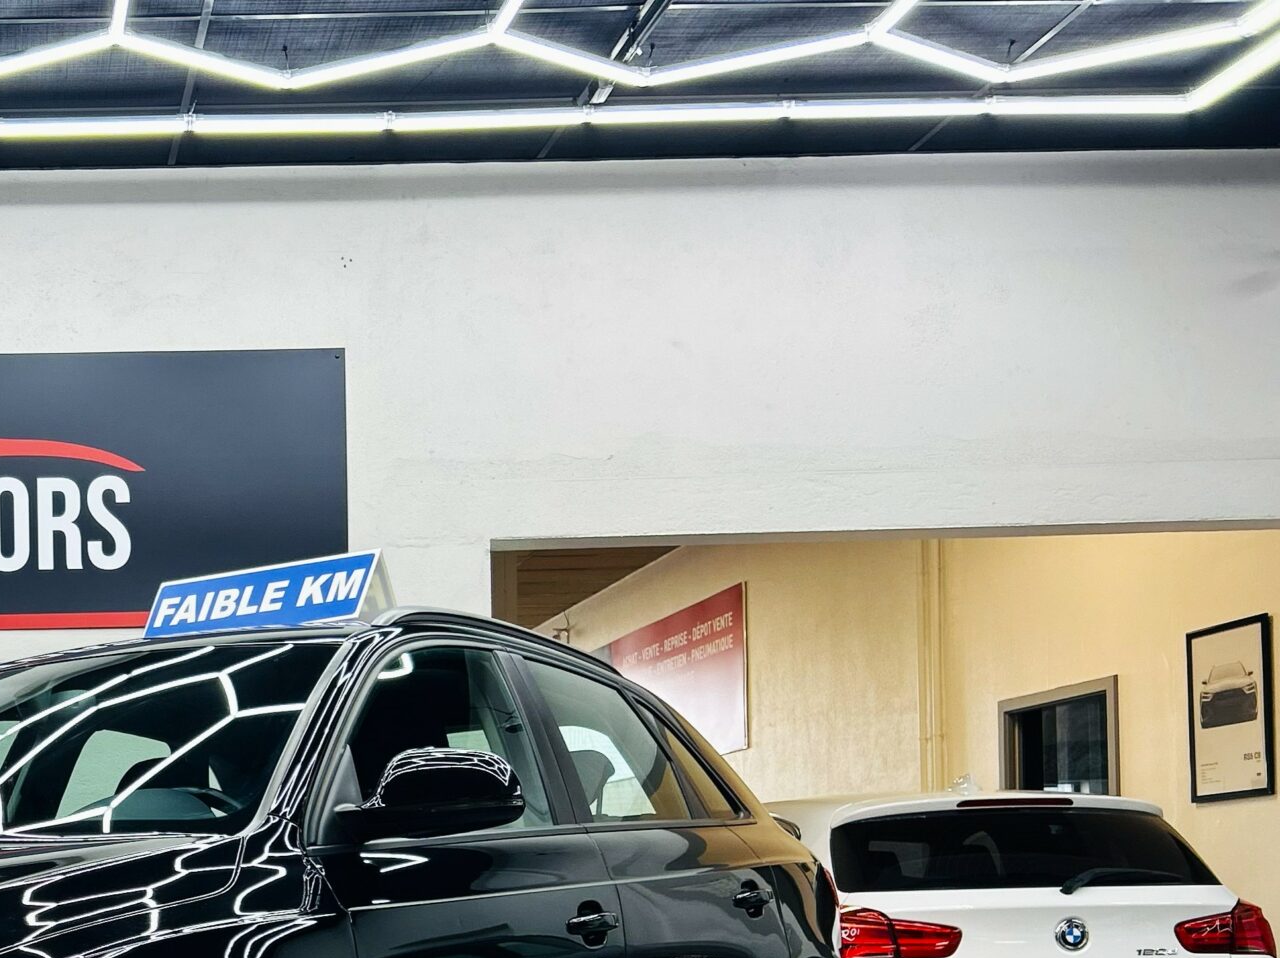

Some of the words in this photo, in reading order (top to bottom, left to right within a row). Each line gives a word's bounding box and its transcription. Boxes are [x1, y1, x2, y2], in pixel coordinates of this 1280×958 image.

[153, 580, 290, 628] FAIBLE
[296, 568, 366, 608] KM
[641, 643, 660, 661] VENTE
[663, 631, 688, 654] REPRISE
[691, 620, 712, 642] DÉPOT
[713, 611, 734, 633] VENTE
[690, 634, 734, 664] PNEUMATIQUE
